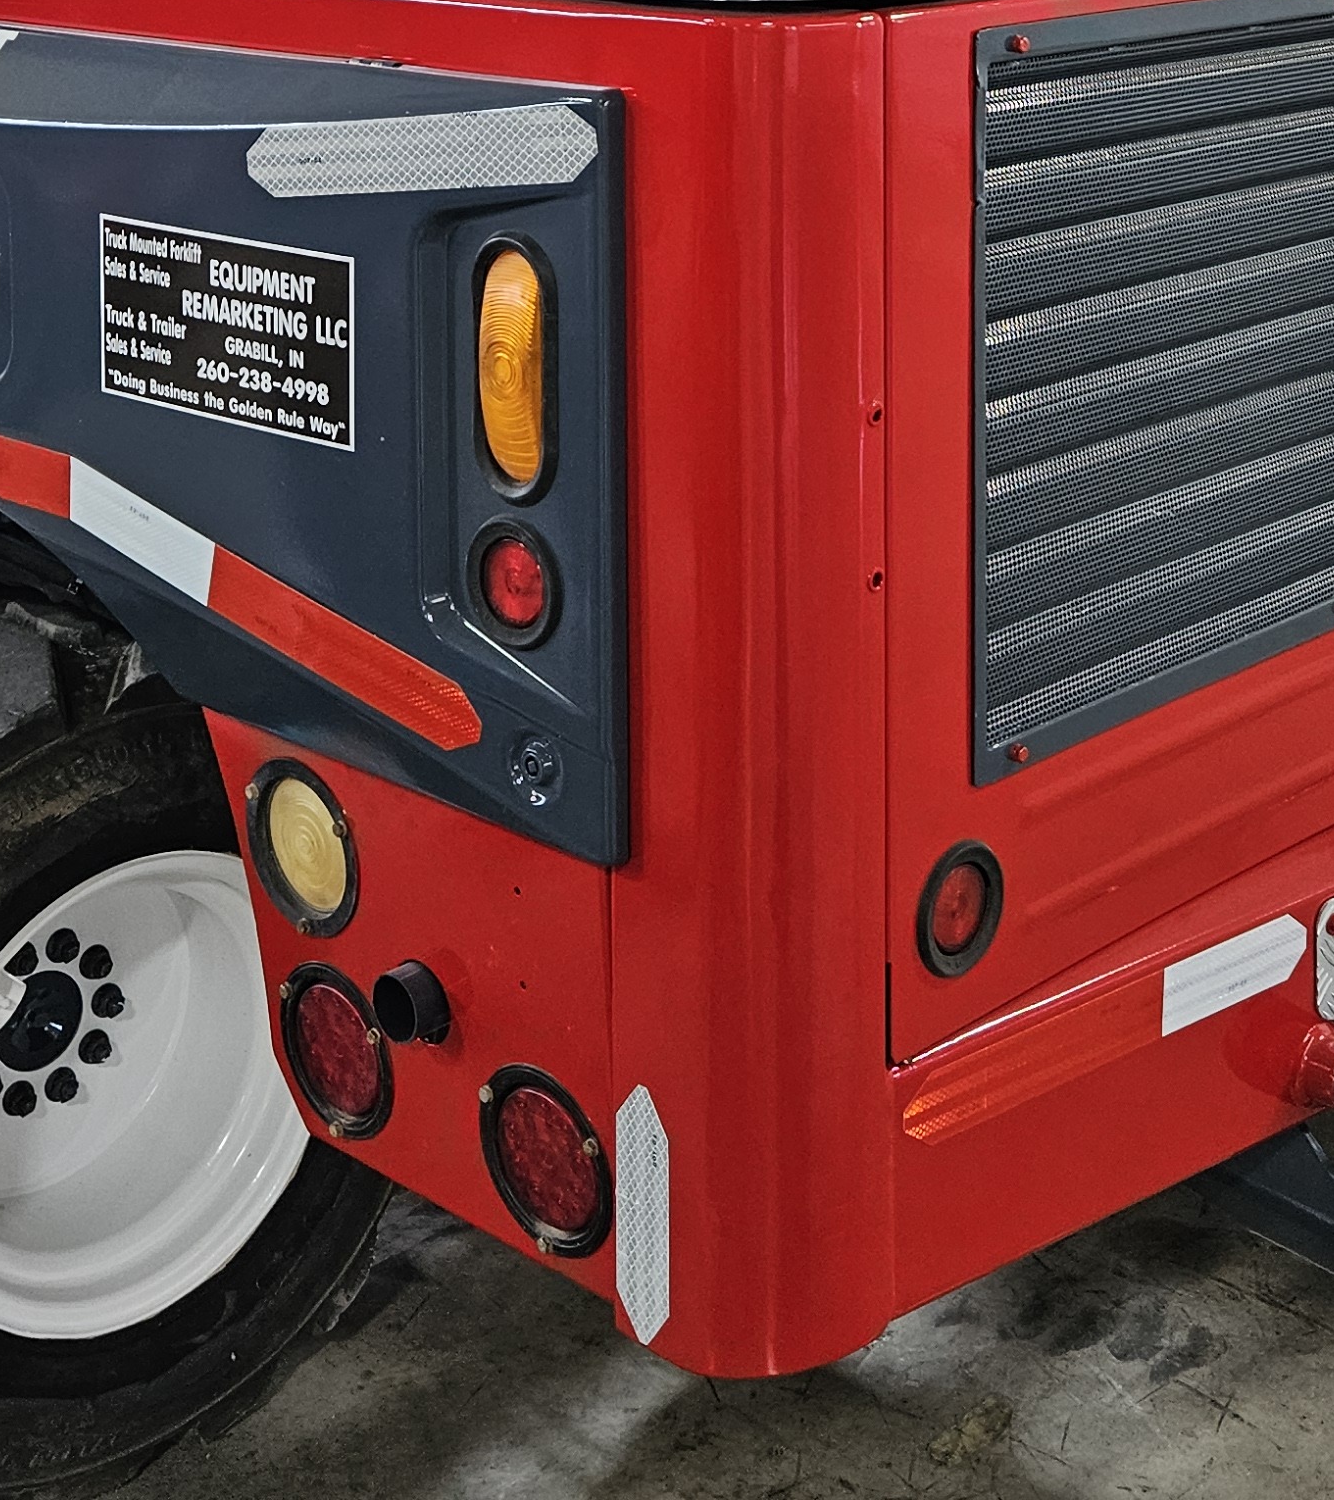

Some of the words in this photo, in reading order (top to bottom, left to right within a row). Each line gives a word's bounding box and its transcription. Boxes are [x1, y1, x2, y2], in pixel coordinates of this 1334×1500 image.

[104, 227, 127, 250] Truck
[129, 232, 167, 258] Mounted
[170, 239, 202, 264] Forklift
[104, 255, 127, 280] Sales
[129, 260, 137, 281] &
[139, 262, 171, 288] Service
[209, 259, 316, 305] EQUIPMENT
[104, 303, 135, 328] Truck
[137, 311, 147, 331] &
[150, 313, 187, 340] Trailer
[182, 289, 308, 341] REMARKETING
[315, 316, 348, 349] LLC
[105, 332, 128, 356] Sales
[130, 338, 139, 358] &
[140, 339, 172, 366] Service
[225, 336, 284, 369] GRABILL,
[288, 349, 305, 369] IN
[196, 358, 330, 406] 260-238-4998
[149, 377, 200, 405] Business
[203, 391, 225, 411] the
[228, 397, 273, 422] Golden
[277, 408, 305, 430] Rule
